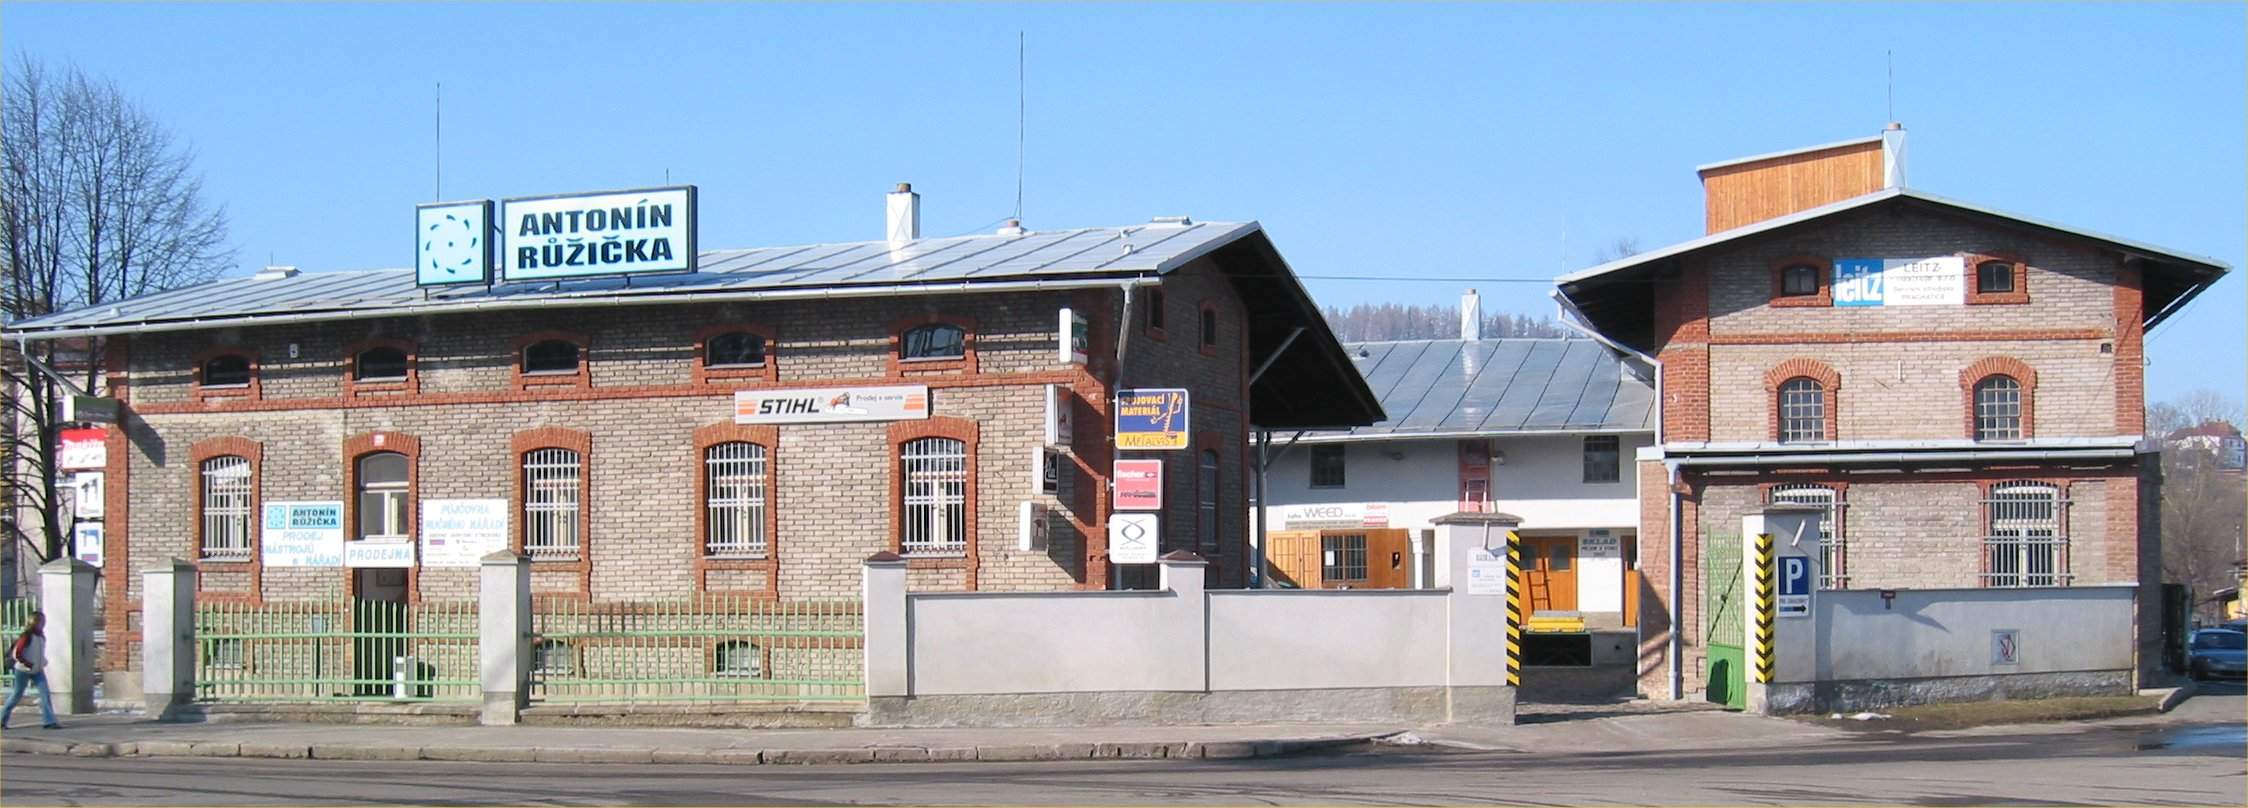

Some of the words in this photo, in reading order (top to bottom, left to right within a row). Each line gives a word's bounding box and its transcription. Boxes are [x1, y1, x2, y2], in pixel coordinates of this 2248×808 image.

[519, 198, 672, 237] ANTONÍN
[518, 236, 673, 269] RŮŽIČKA
[1903, 262, 1940, 273] LEITZ
[1835, 263, 1883, 302] leitz
[759, 398, 820, 414] STIHL
[1120, 405, 1160, 417] MATERIÁL
[292, 507, 337, 517] ANTONÍN
[1304, 506, 1343, 518] WEED
[292, 516, 337, 526] RŮŽIČKA
[282, 530, 324, 542] PRODEJ
[349, 547, 411, 561] PRODEJNA
[1786, 558, 1803, 594] P
